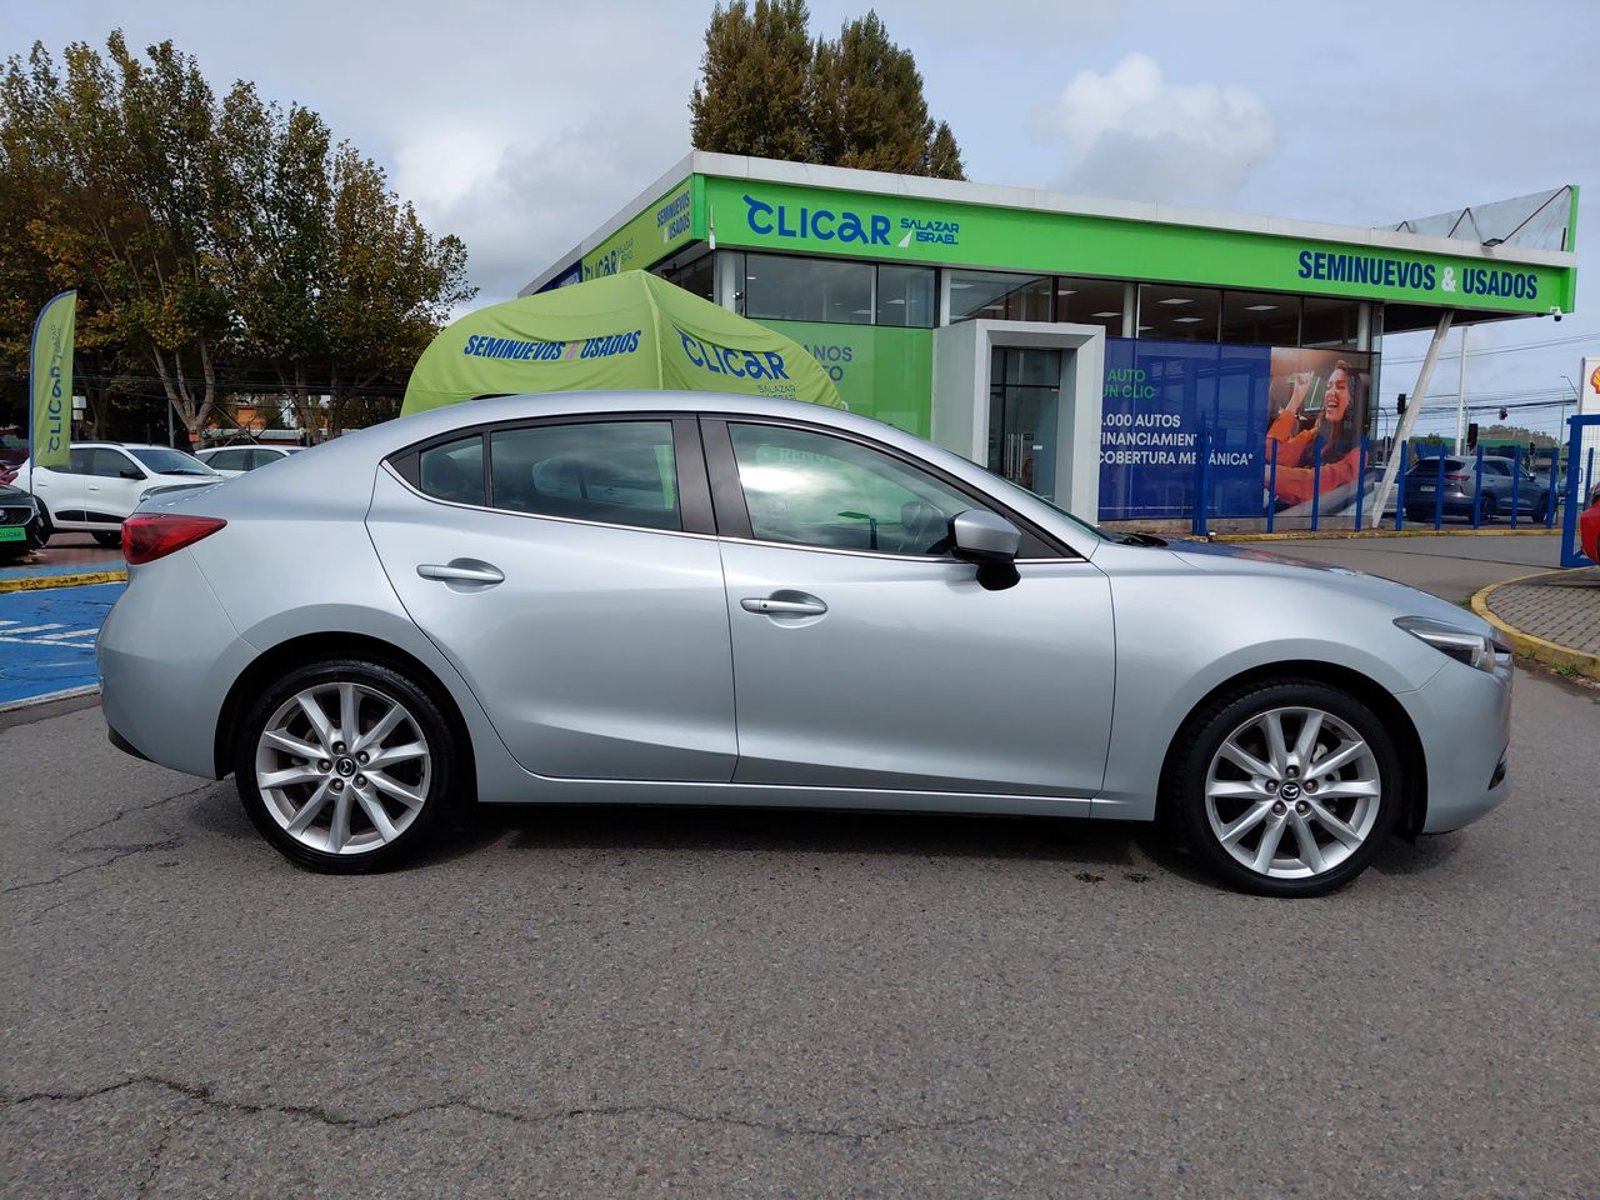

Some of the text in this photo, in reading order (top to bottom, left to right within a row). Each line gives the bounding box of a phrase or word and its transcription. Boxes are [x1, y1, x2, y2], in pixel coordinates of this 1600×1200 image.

[900, 217, 960, 234] SALAZAR
[916, 231, 959, 245] ISRAEL
[1298, 250, 1538, 300] SEMINUEVOS & USADOS
[464, 334, 567, 361] SEMINUEVOS
[580, 329, 642, 360] USADOS
[1107, 368, 1146, 382] AUTO
[1121, 385, 1156, 399] CLIC
[1100, 413, 1181, 428] .000 AUTOS
[1178, 450, 1253, 465] MEÁNICA
